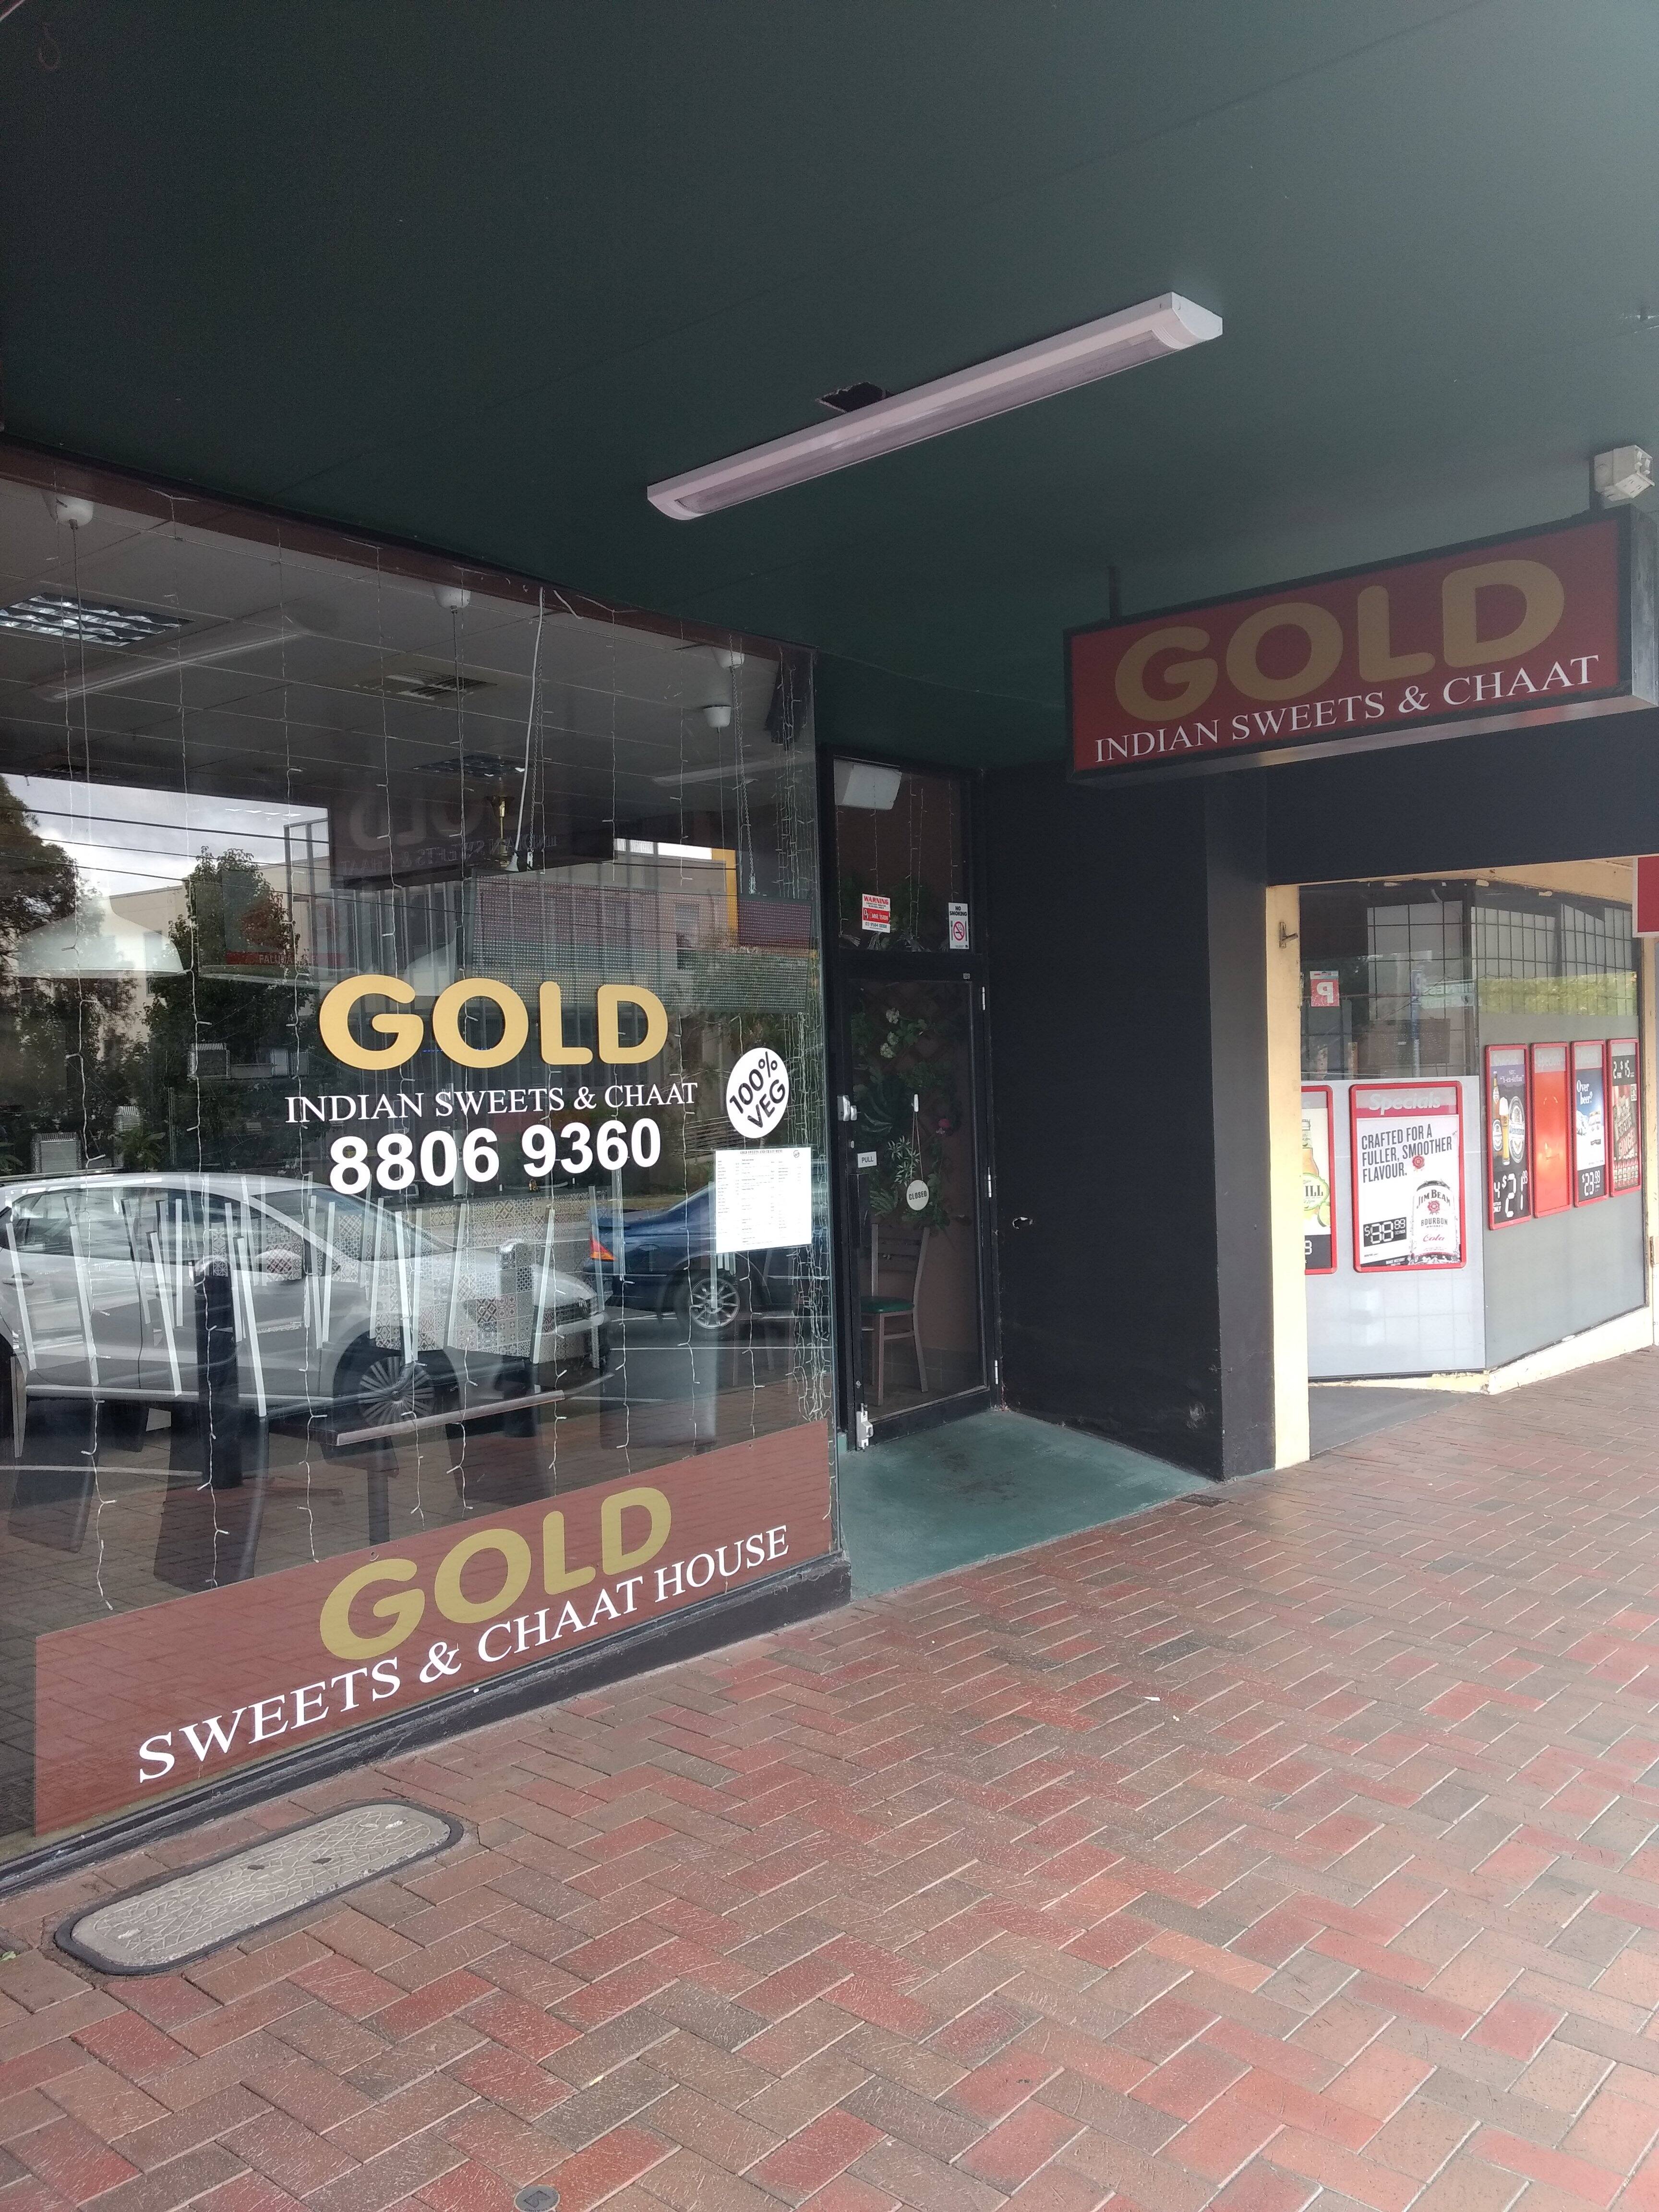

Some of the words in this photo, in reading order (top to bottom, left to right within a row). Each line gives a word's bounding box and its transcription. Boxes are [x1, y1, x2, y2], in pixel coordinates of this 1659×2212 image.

[1115, 559, 1565, 722] GOLD
[1094, 719, 1220, 763] INDIAN
[1231, 691, 1385, 741] SWEETS
[1397, 685, 1431, 714] &
[1443, 654, 1600, 706] CHAAT
[864, 895, 889, 905] WARNING
[319, 974, 668, 1070] GOLD
[729, 1051, 778, 1114] 100%
[1576, 1080, 1589, 1093] Over
[285, 1092, 424, 1123] INDIAN
[435, 1087, 564, 1116] SWEETS
[577, 1086, 596, 1110] &
[604, 1082, 698, 1108] CHAAT
[747, 1079, 786, 1129] VEG
[1369, 1091, 1441, 1116] Specials
[1580, 1091, 1593, 1105] beer?
[1361, 1129, 1403, 1150] CRAFTED
[1407, 1125, 1424, 1142] FOR
[1426, 1123, 1432, 1138] A
[329, 1127, 500, 1195] 8806
[521, 1118, 661, 1178] 9360
[862, 1155, 874, 1164] PULL
[1362, 1146, 1400, 1167] FULLER,
[1402, 1136, 1452, 1160] SMOOTHER
[1363, 1162, 1407, 1183] FLAVOUR.
[909, 1190, 927, 1201] CLOSED
[1416, 1191, 1430, 1209] JIM
[1431, 1189, 1451, 1207] BEAM
[1421, 1217, 1448, 1226] BOURBON
[1423, 1233, 1445, 1242] Cola
[319, 1486, 673, 1662] GOLD
[137, 1657, 402, 1786] SWEETS
[418, 1641, 463, 1686] &
[478, 1576, 644, 1663] CHAAT
[656, 1524, 790, 1602] HOUSE
